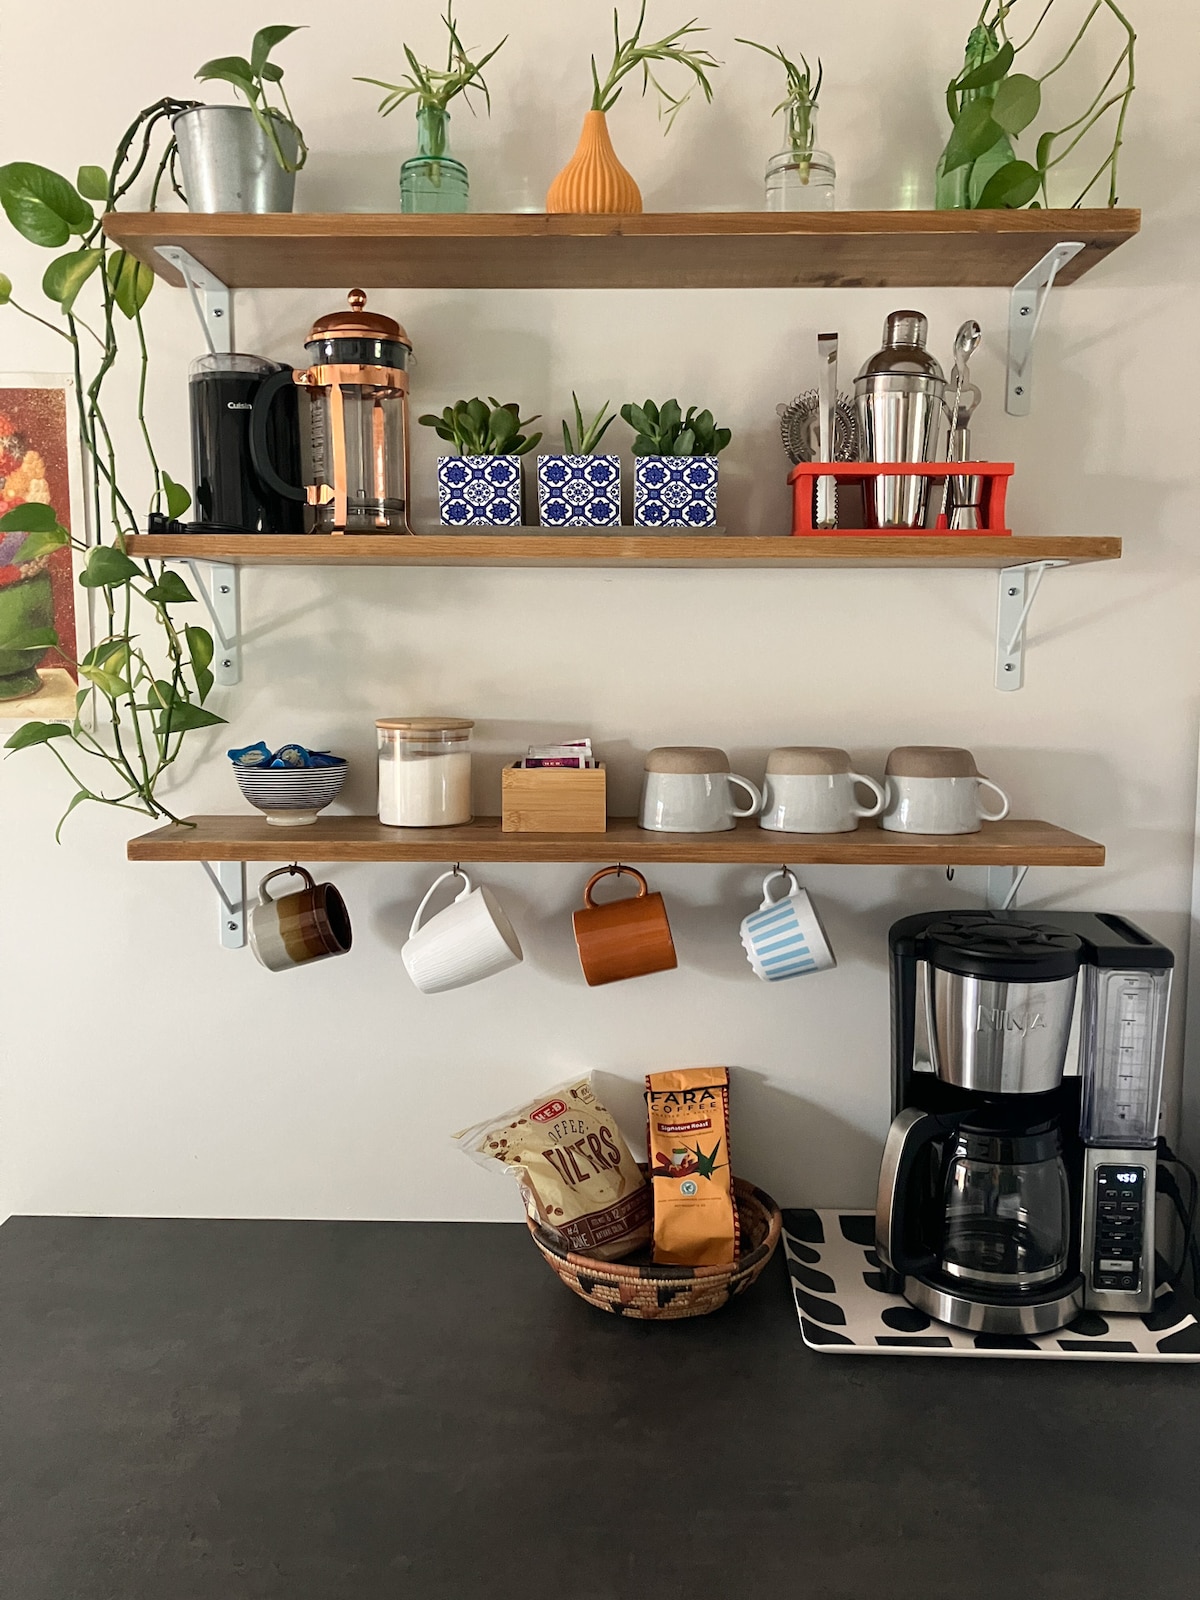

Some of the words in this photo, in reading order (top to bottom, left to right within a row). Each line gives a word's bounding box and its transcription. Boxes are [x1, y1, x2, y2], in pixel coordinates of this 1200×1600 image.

[976, 1004, 1047, 1038] NINJA
[650, 1089, 715, 1105] FARA
[651, 1101, 717, 1114] COFFEE
[547, 1119, 585, 1144] OFFEE
[660, 1124, 690, 1132] Signature
[690, 1121, 709, 1129] Roast
